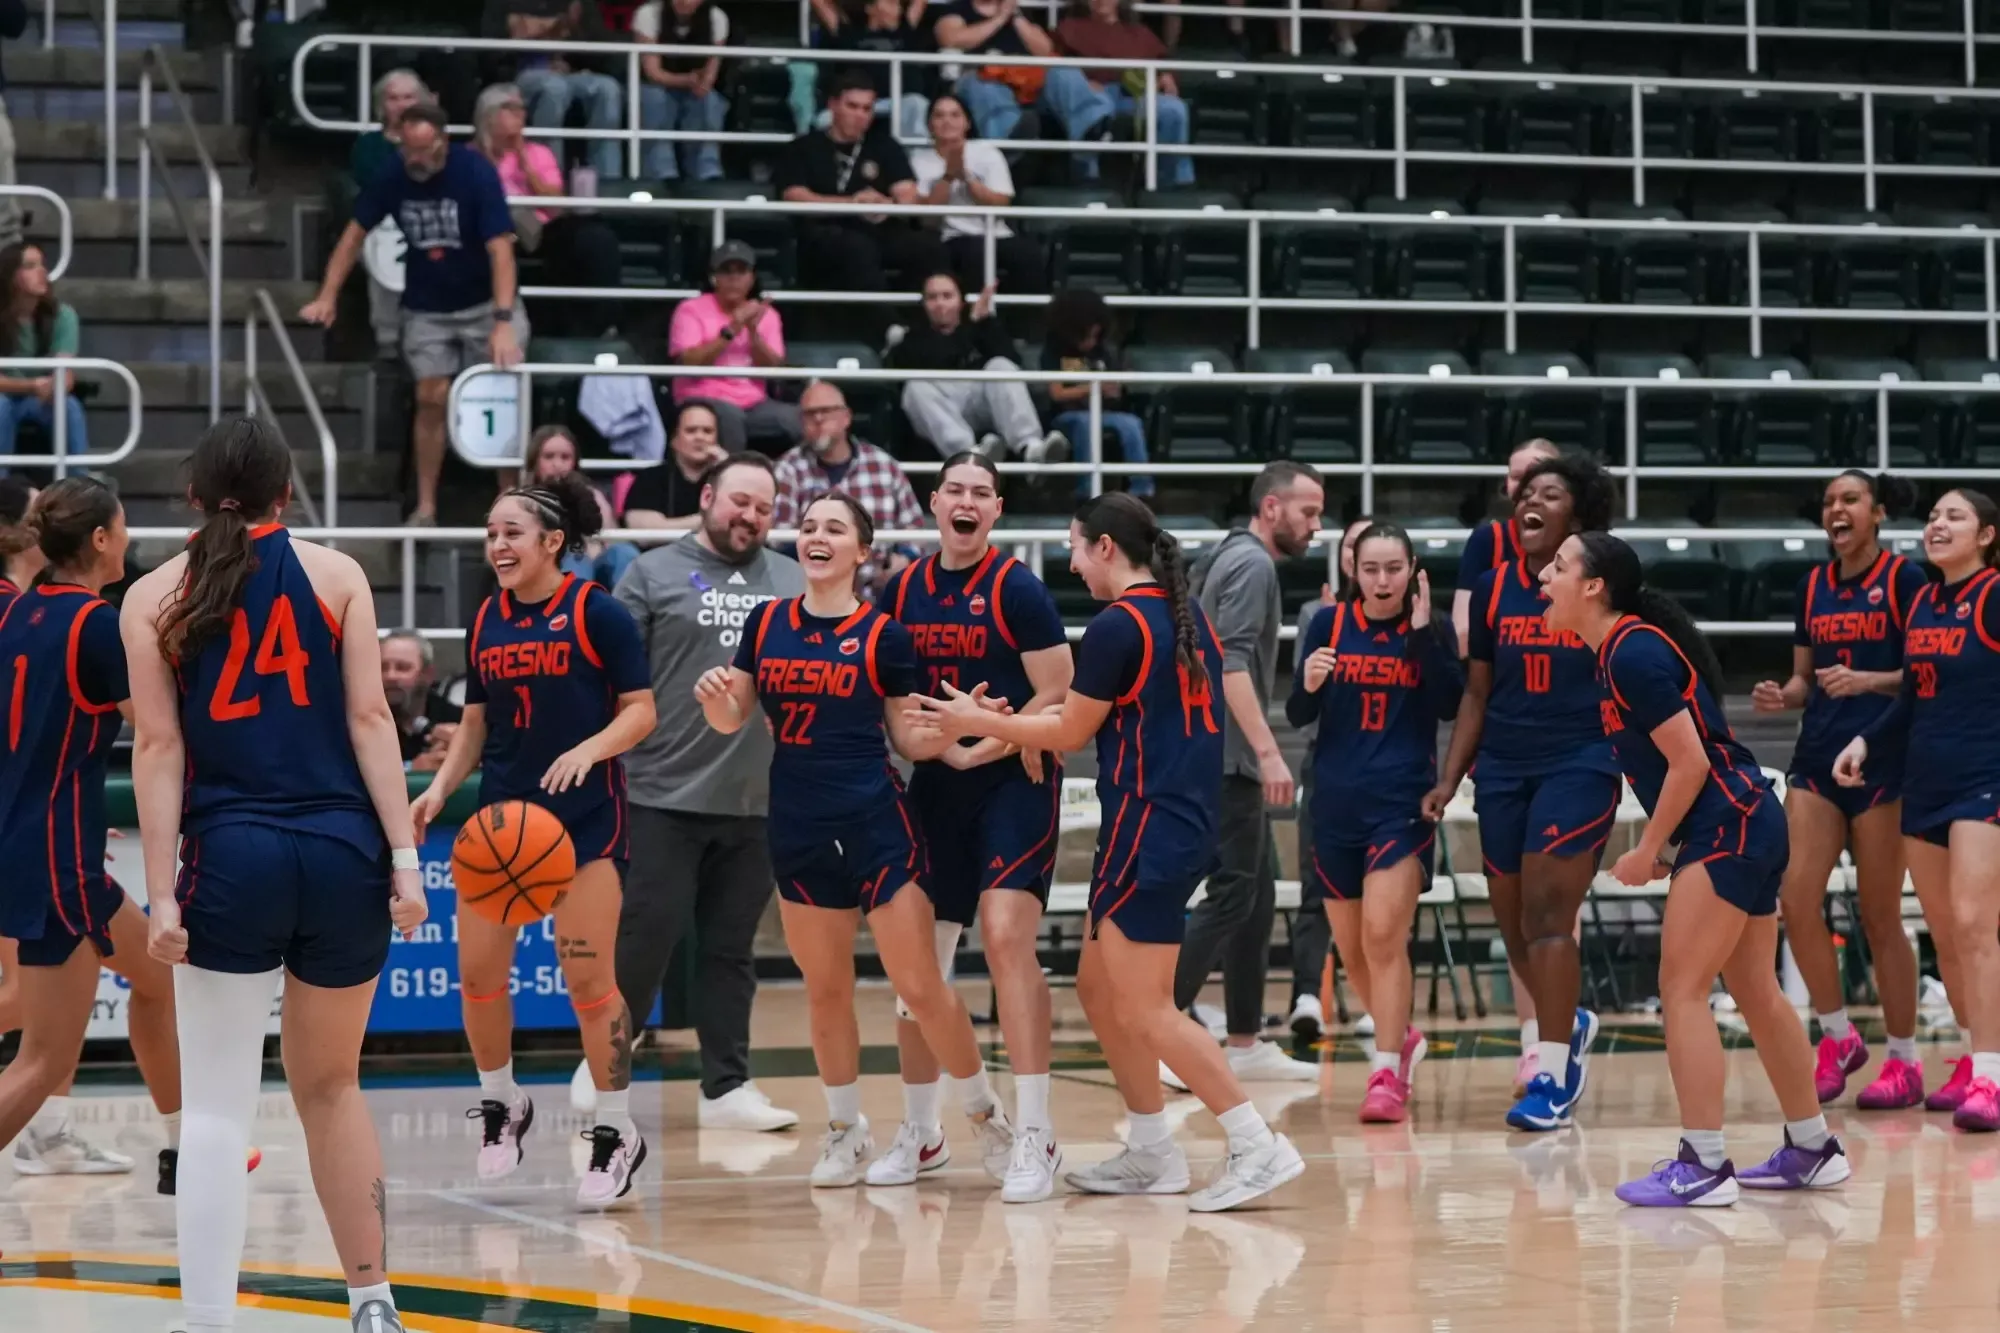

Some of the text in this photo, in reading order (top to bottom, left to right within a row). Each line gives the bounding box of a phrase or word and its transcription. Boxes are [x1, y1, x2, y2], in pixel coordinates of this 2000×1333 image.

[482, 408, 495, 437] 1
[1809, 611, 1888, 645] FRESNO
[1905, 627, 1968, 657] FRESNO
[209, 594, 311, 722] 24
[479, 641, 572, 687] FRESNO
[757, 657, 859, 698] FRESNO
[1333, 653, 1422, 688] FRESNO
[1522, 652, 1551, 693] 10
[780, 701, 817, 745] 22
[1360, 691, 1388, 731] 13
